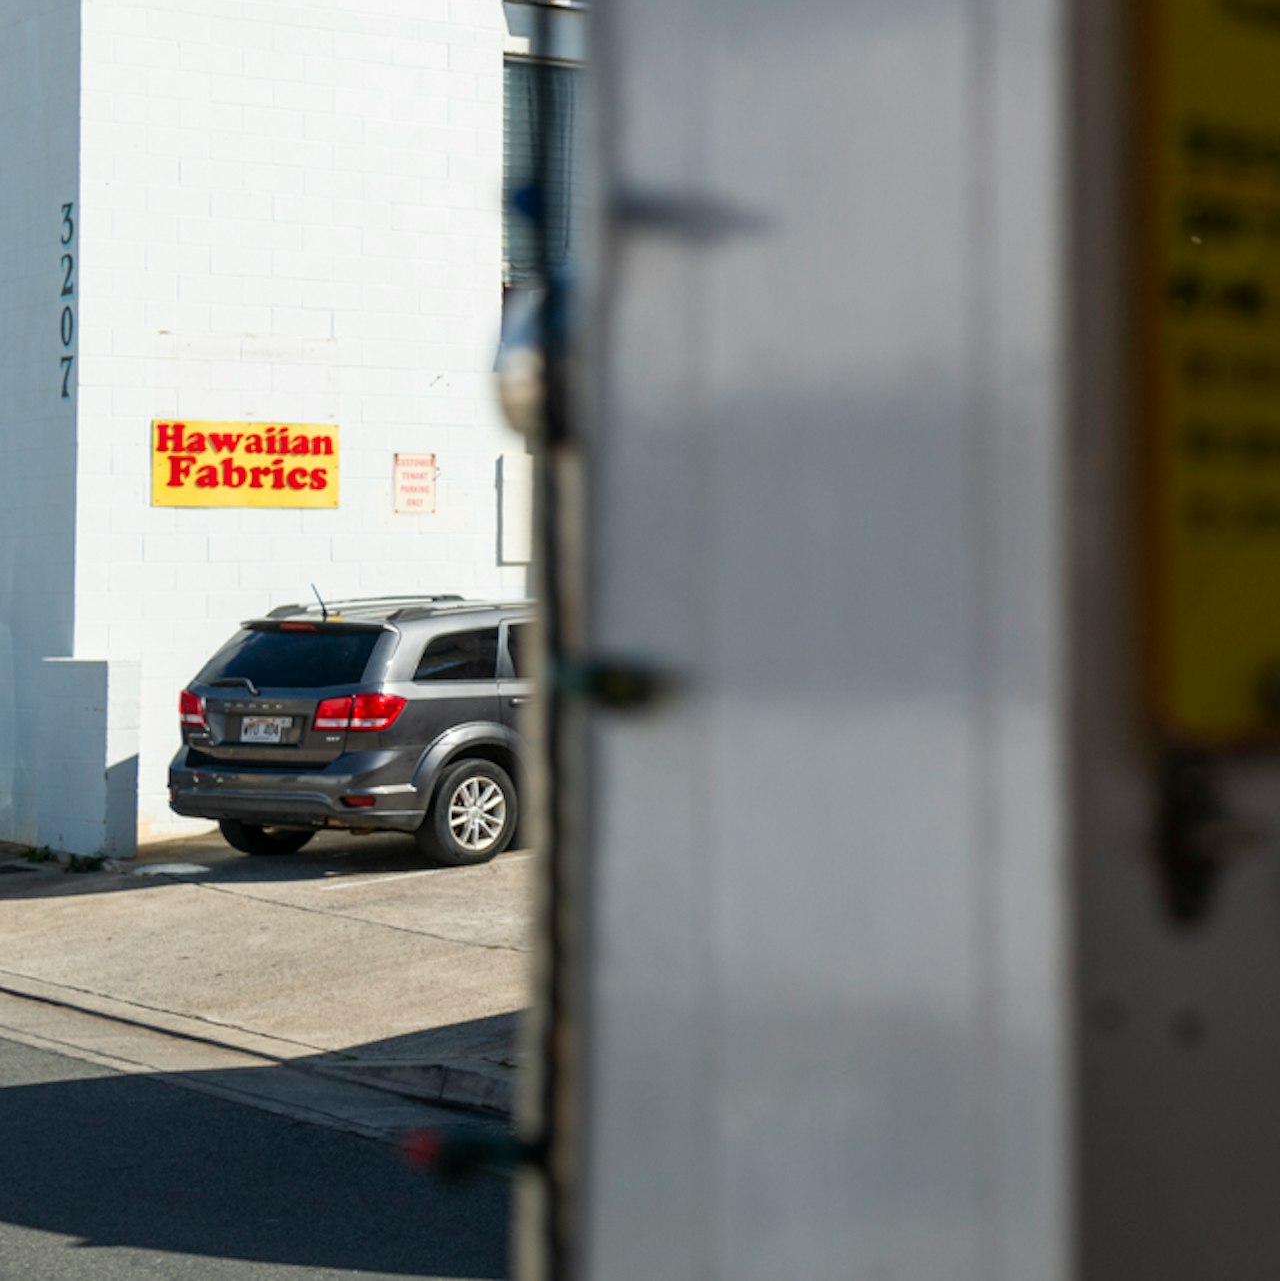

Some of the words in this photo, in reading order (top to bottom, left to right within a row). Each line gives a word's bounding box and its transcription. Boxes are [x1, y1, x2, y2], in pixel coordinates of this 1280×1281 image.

[60, 202, 74, 398] 3207
[155, 424, 334, 456] Hawaiian
[166, 455, 329, 491] Fabrics
[403, 472, 427, 480] TENANT
[400, 485, 429, 494] PARKING
[406, 499, 423, 507] ONLY
